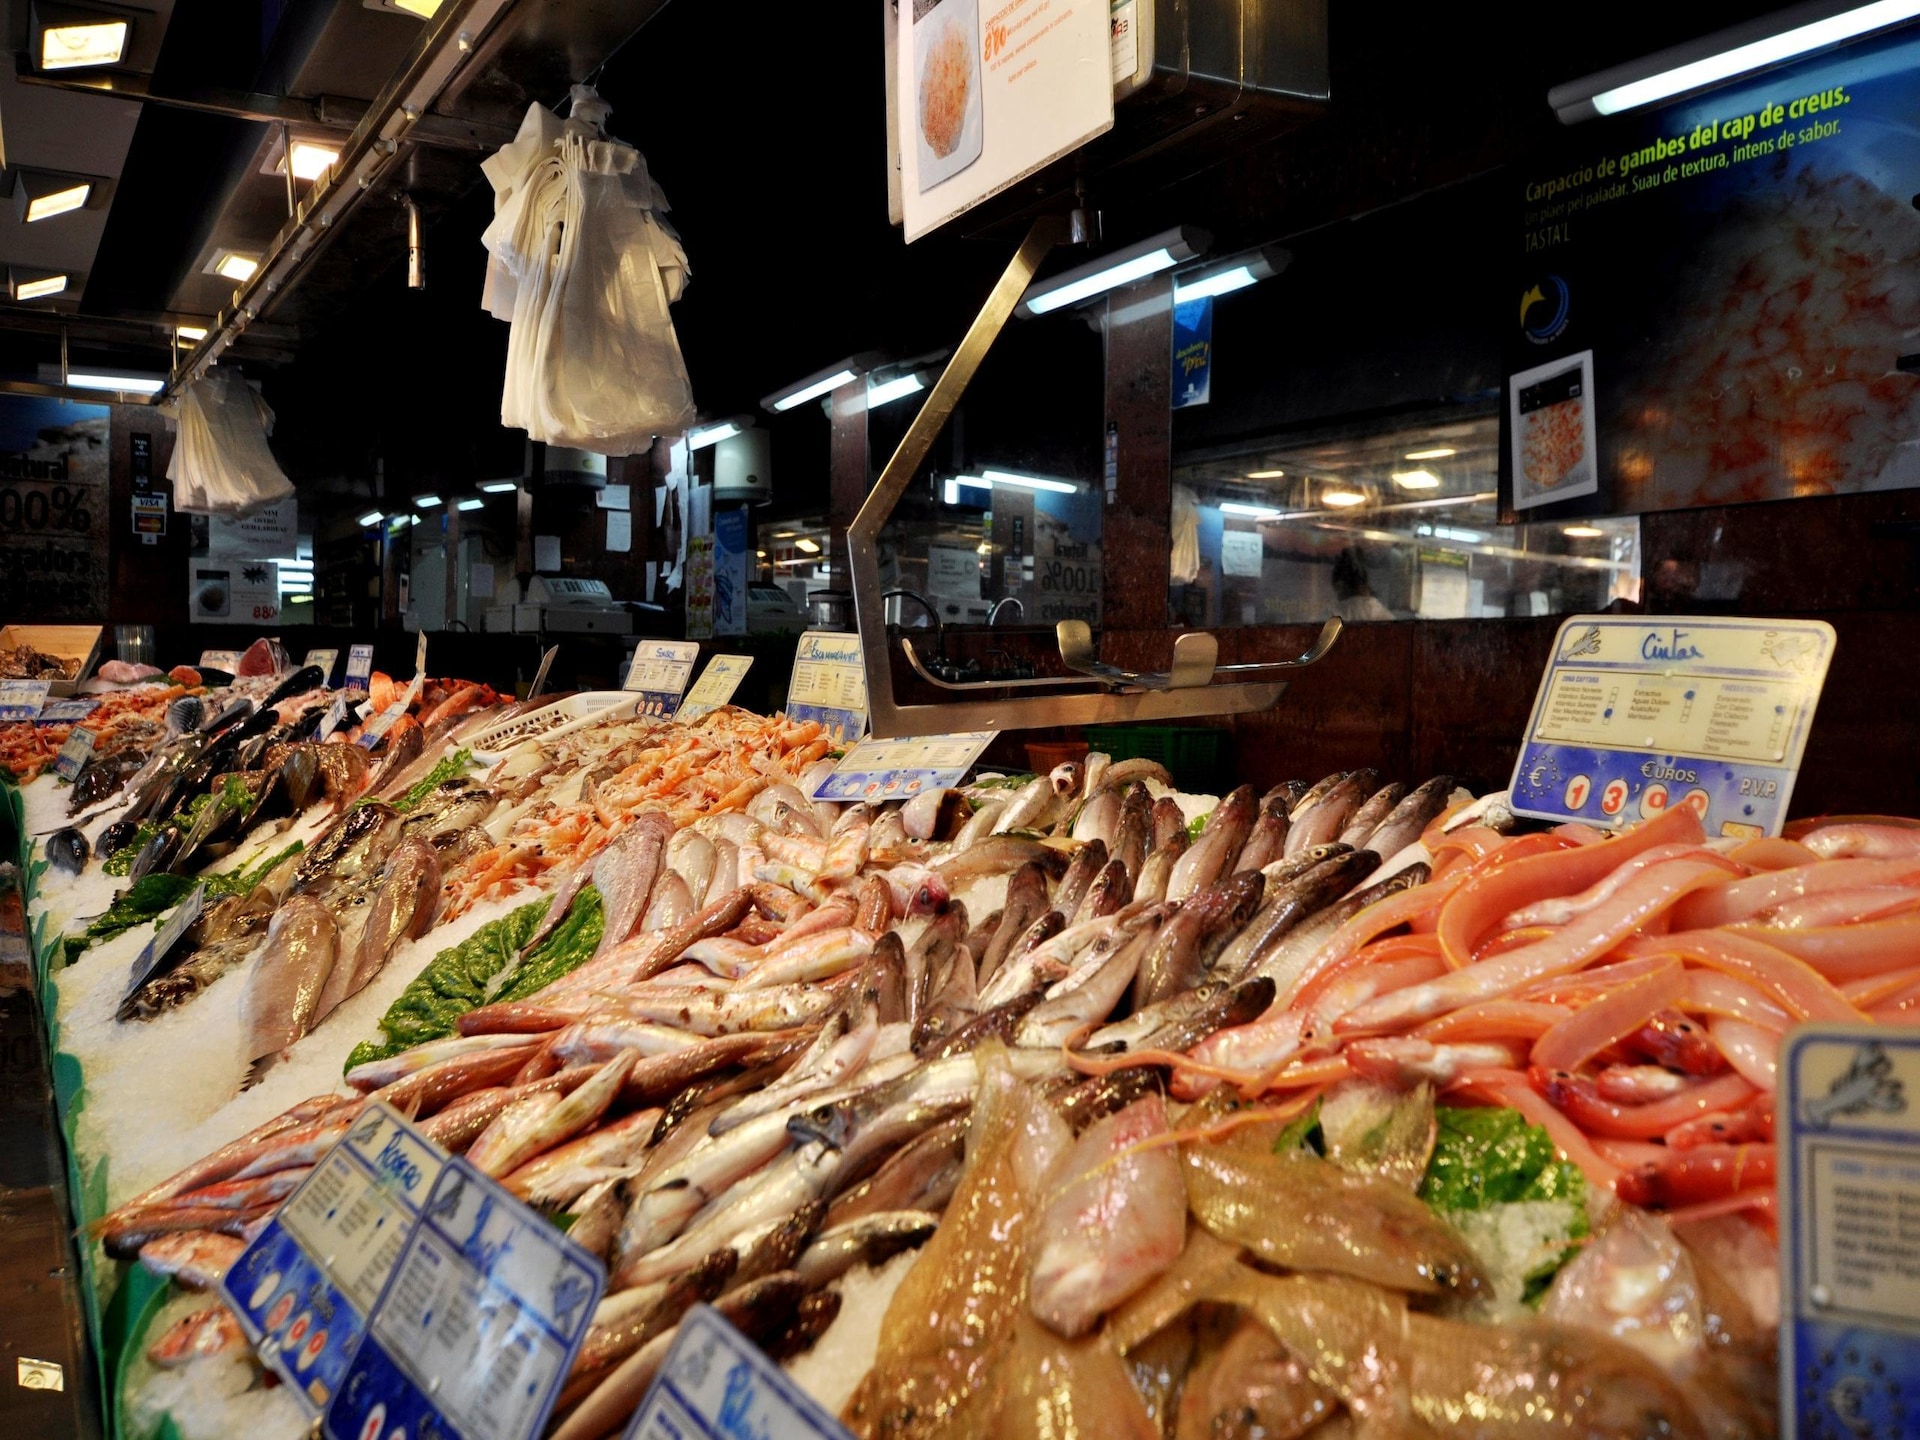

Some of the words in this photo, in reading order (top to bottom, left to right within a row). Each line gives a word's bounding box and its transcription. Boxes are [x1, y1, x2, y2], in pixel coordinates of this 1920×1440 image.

[1525, 167, 1594, 203] Carpaccio
[1597, 157, 1615, 179] de
[1619, 137, 1687, 176] gambes
[1689, 120, 1718, 151] del
[1721, 115, 1755, 143] cap
[1759, 102, 1783, 129] de
[1789, 86, 1851, 118] creus.
[1567, 194, 1584, 215] pel
[1585, 182, 1629, 209] paladar.
[1632, 173, 1661, 195] Suau
[1663, 166, 1679, 183] de
[1681, 151, 1730, 180] textura,
[1733, 137, 1775, 163] intens
[1777, 129, 1795, 151] de
[1798, 119, 1842, 144] sabor.
[0, 486, 91, 532] 00%
[140, 499, 159, 507] VISA
